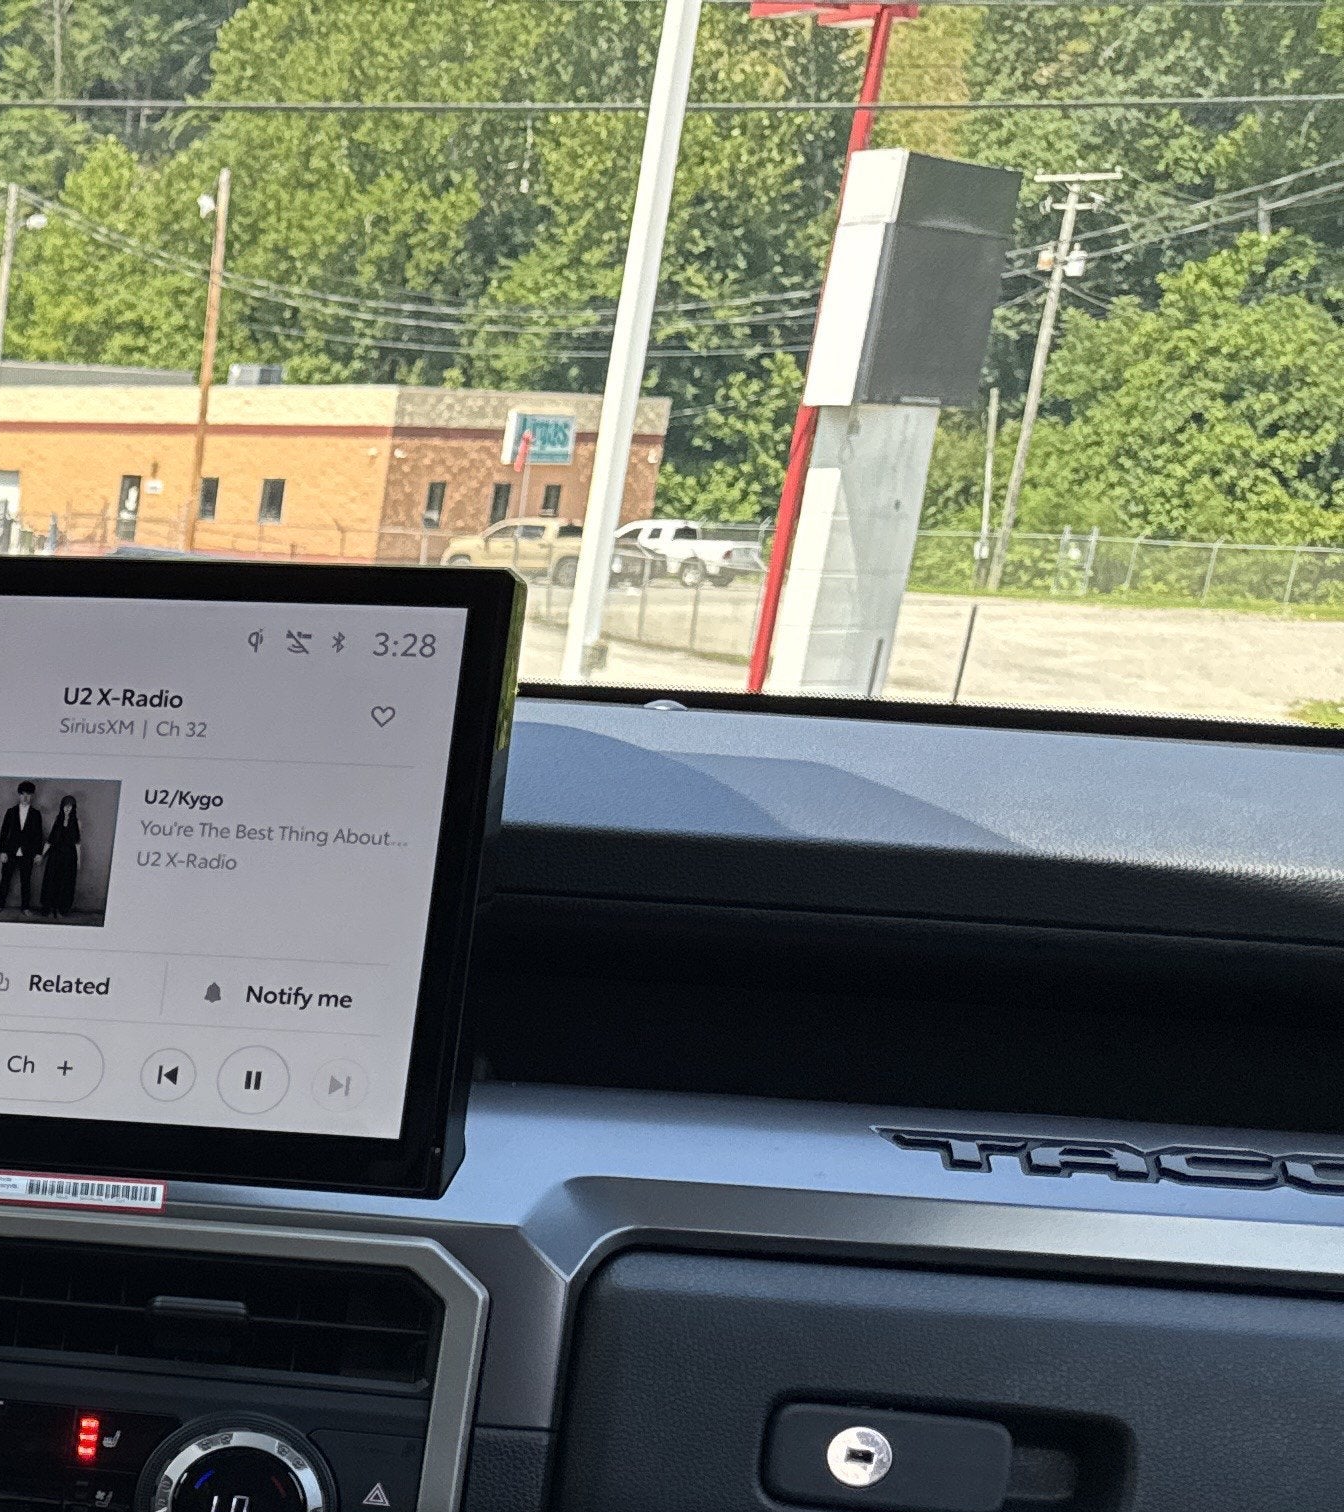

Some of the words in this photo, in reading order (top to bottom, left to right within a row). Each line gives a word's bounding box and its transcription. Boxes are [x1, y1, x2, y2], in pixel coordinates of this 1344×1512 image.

[372, 632, 438, 659] 3:28
[63, 687, 92, 707] U2
[96, 688, 184, 709] X-Radio
[59, 717, 135, 738] SiriusXM
[155, 720, 182, 739] Ch
[185, 721, 208, 739] 32
[144, 789, 224, 811] U2/Kygo
[140, 820, 195, 840] You're
[198, 822, 231, 842] The
[235, 823, 275, 843] Best
[277, 825, 329, 848] Thing
[136, 851, 162, 868] U2
[165, 852, 238, 873] X-Radio
[28, 974, 111, 996] Related
[245, 985, 313, 1011] Notify
[317, 990, 354, 1010] me
[6, 1054, 36, 1075] Ch
